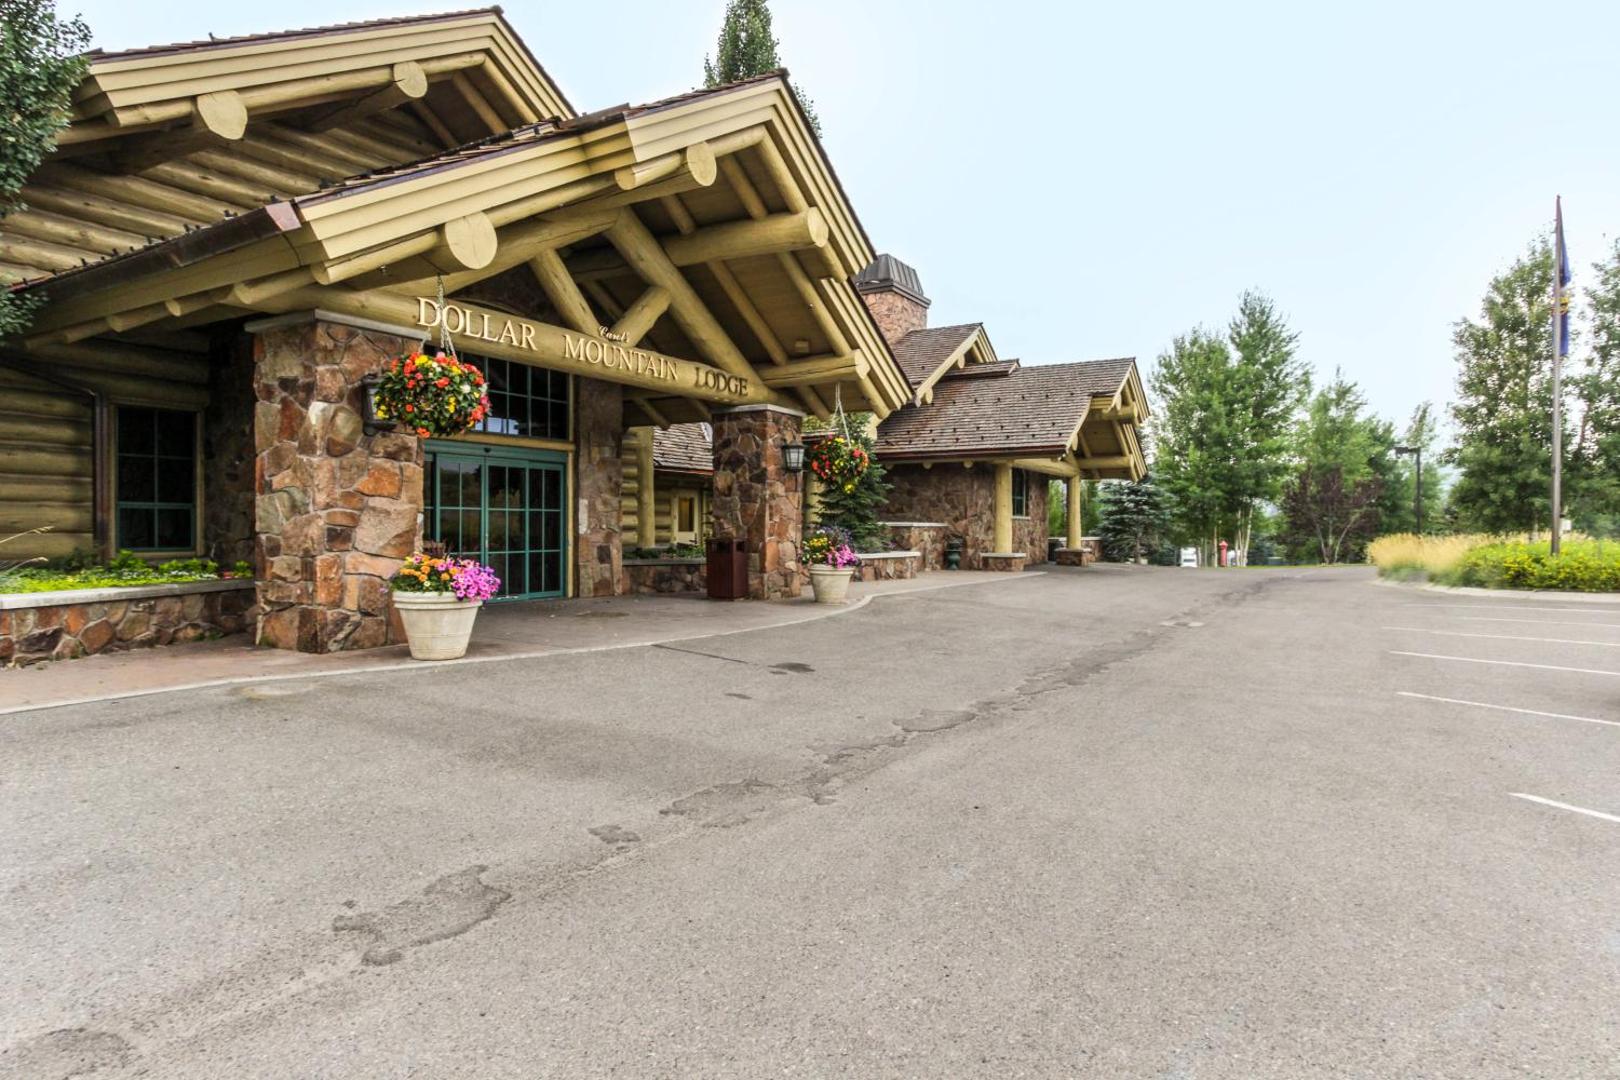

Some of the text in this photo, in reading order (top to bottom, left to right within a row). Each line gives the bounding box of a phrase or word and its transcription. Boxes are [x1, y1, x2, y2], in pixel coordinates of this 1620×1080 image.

[417, 297, 749, 397] DOLLAR MOUNTAIN LODGE
